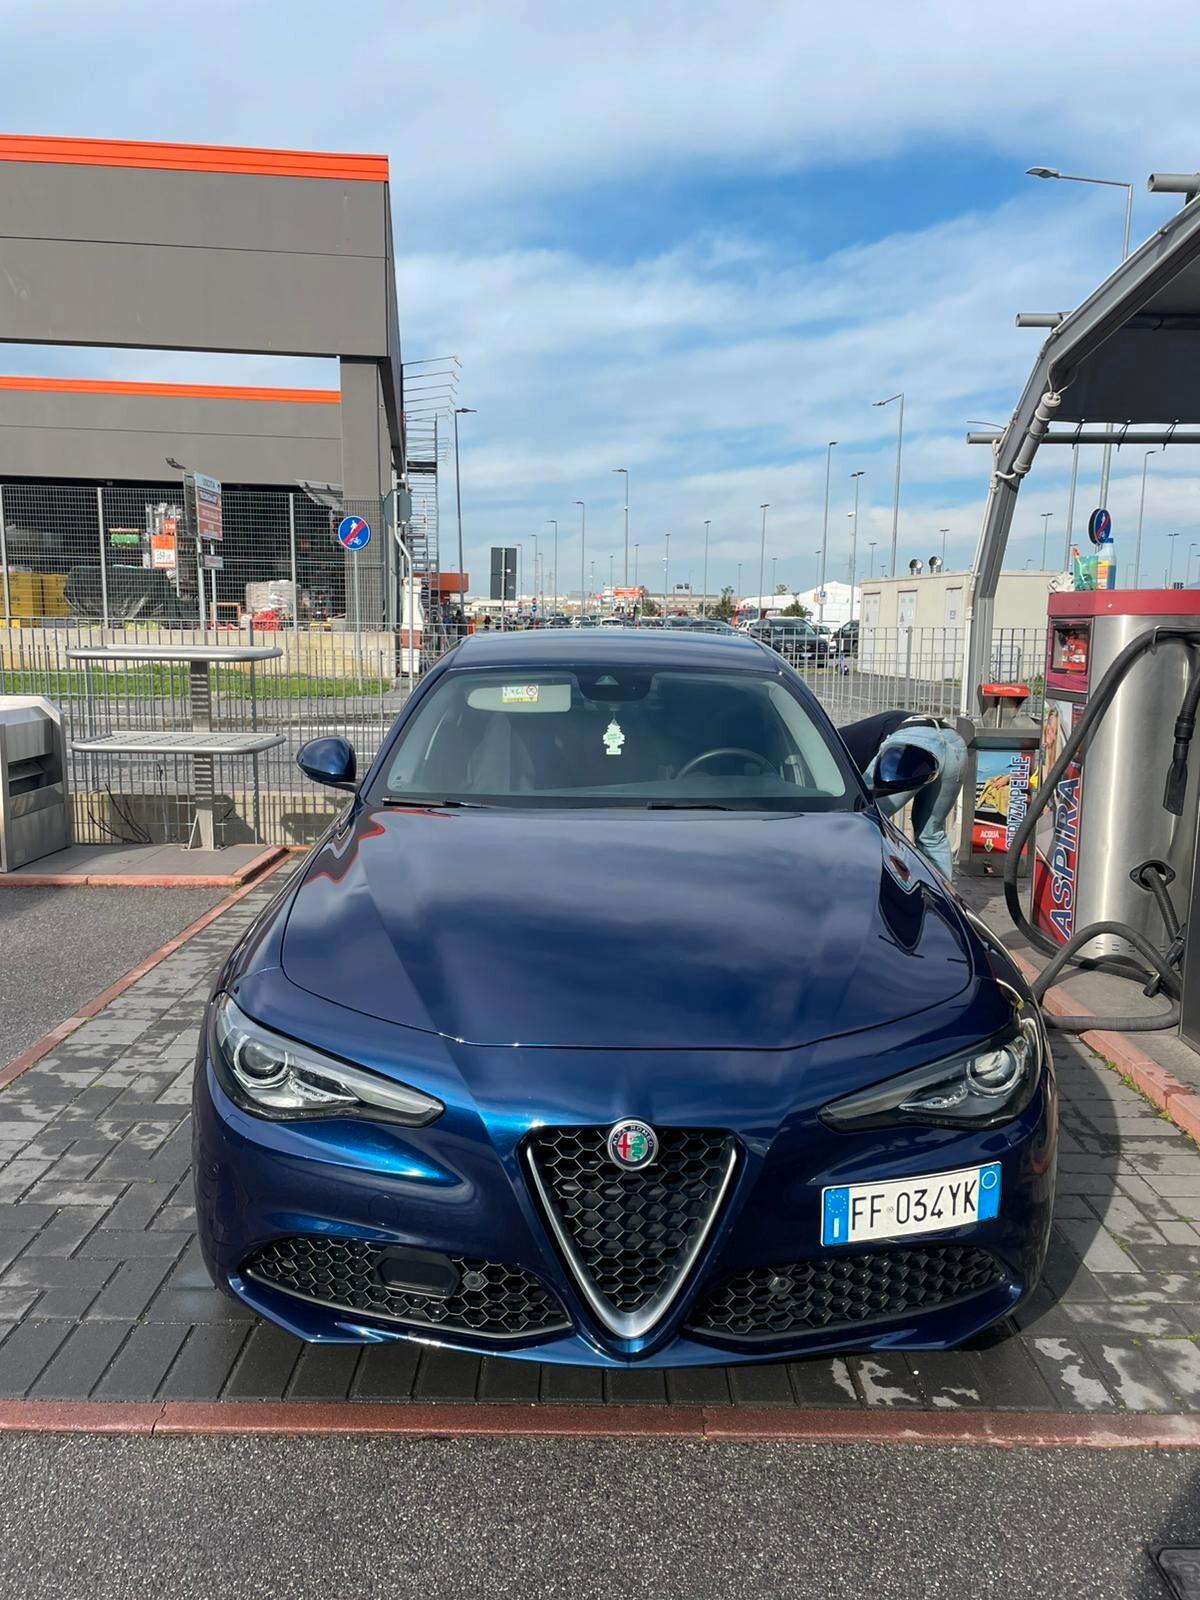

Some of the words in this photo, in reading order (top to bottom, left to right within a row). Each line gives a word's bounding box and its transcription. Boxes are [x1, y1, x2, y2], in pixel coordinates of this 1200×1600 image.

[980, 830, 1000, 838] ACQUA
[1050, 777, 1081, 942] ASPIRA
[612, 1128, 627, 1146] ALFA
[630, 1125, 654, 1147] ROMEO
[851, 1194, 885, 1231] FF
[896, 1179, 977, 1225] 034YK
[833, 1218, 840, 1238] I
